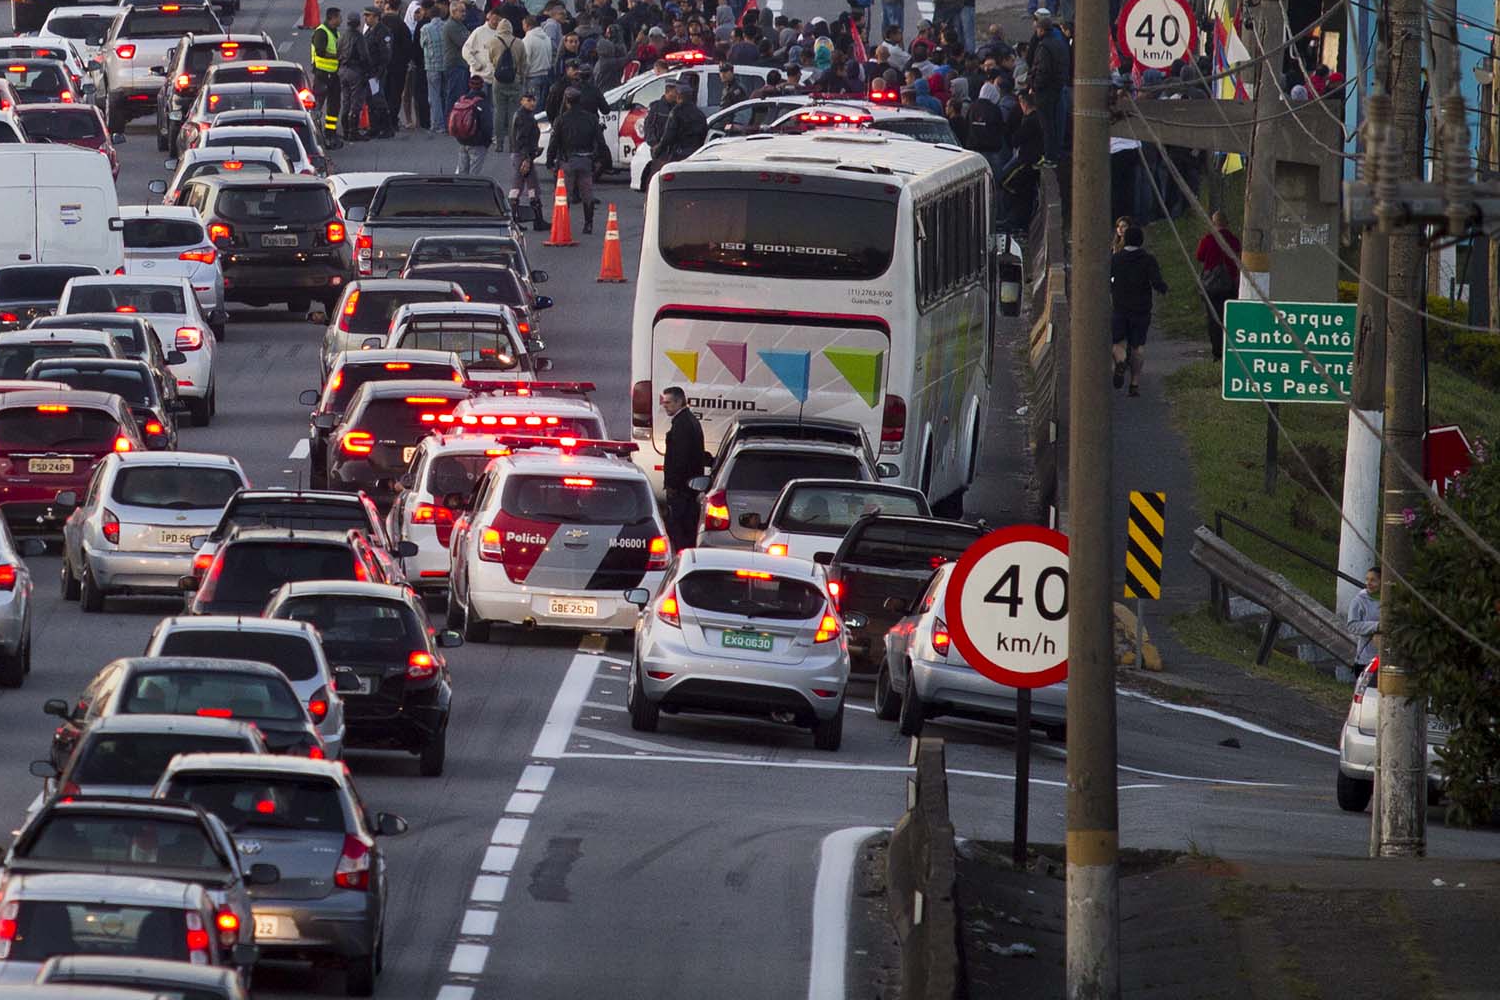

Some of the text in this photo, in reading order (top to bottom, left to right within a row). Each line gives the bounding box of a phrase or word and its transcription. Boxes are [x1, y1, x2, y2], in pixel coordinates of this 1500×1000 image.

[1134, 14, 1180, 47] 40
[1142, 50, 1173, 60] km/h
[720, 242, 746, 251] ISO
[1274, 310, 1344, 328] Parque
[1235, 328, 1351, 346] Santo Antô
[1253, 358, 1290, 374] Rua
[1231, 378, 1272, 392] Dias
[1283, 378, 1329, 394] Paes
[506, 531, 647, 549] Polícia M-06001
[983, 564, 1069, 621] 40
[997, 632, 1056, 656] km/h
